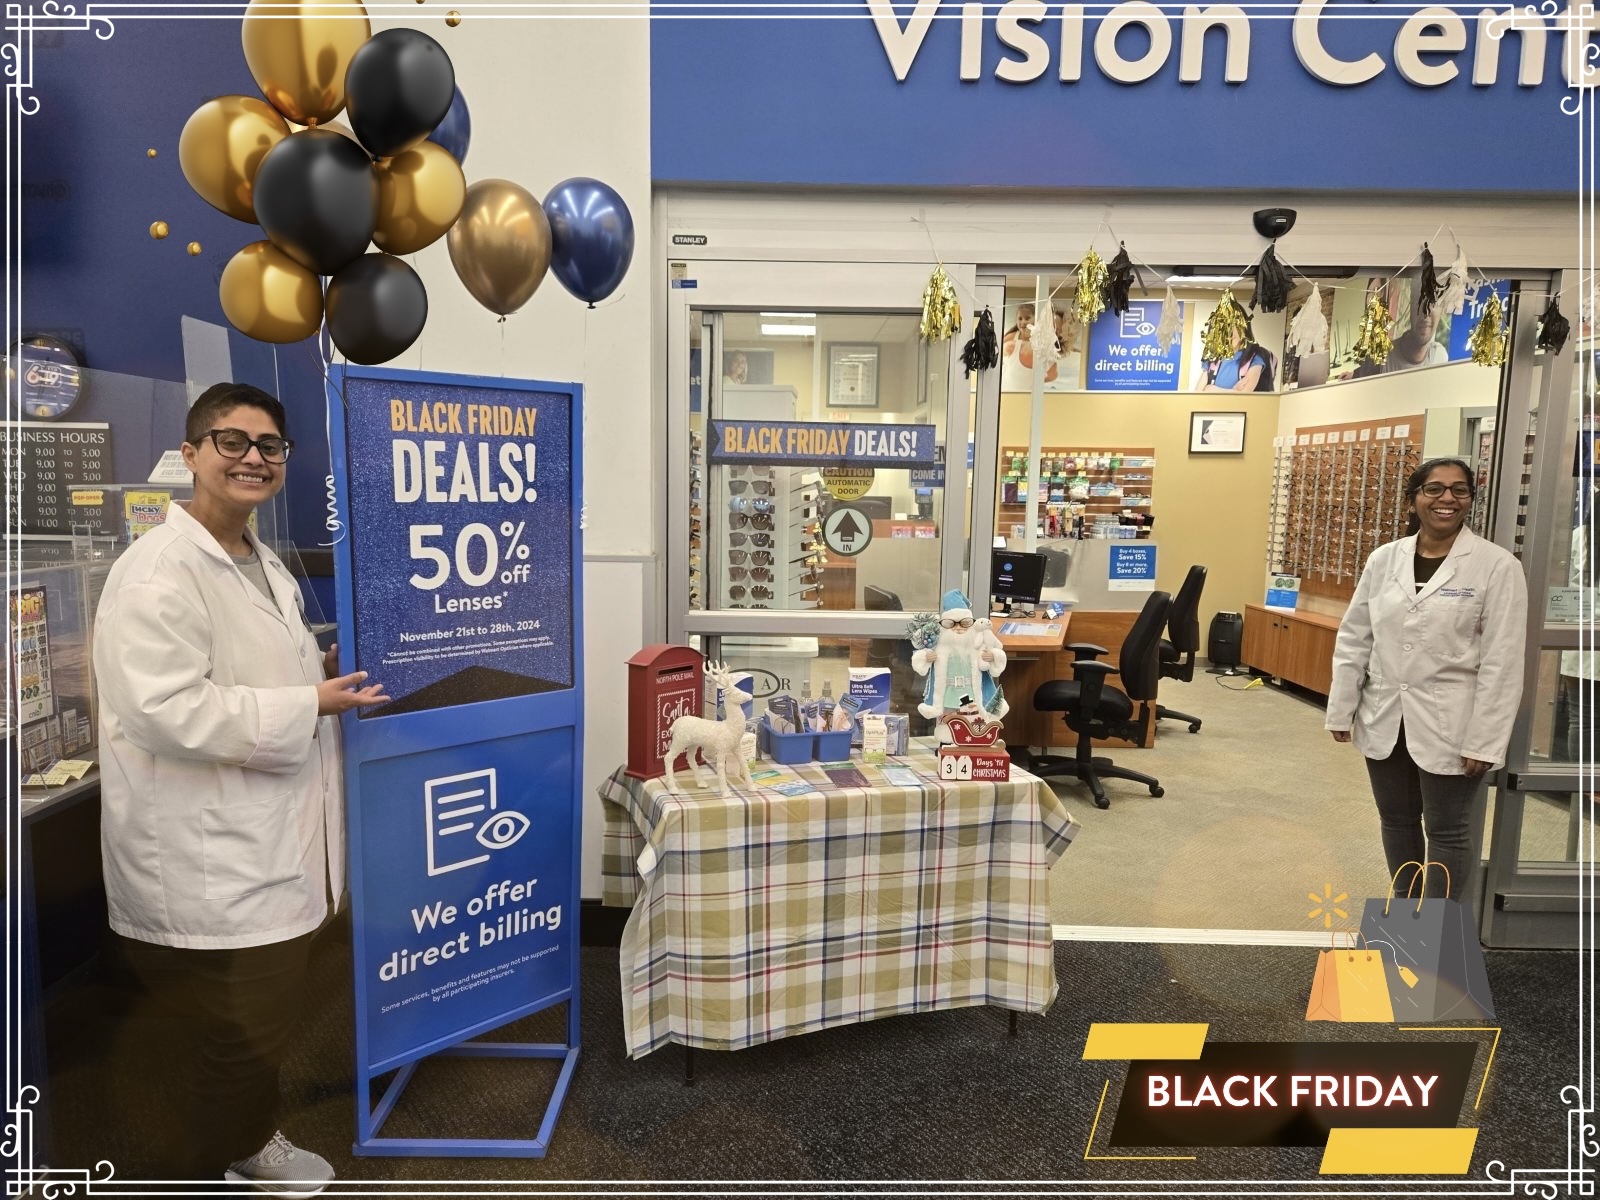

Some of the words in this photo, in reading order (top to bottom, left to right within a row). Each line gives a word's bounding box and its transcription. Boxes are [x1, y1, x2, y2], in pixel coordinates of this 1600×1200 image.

[870, 0, 1251, 84] Vision
[674, 236, 705, 244] STANLEY
[1109, 344, 1128, 357] We
[1094, 359, 1132, 371] direct
[1135, 359, 1174, 374] billing
[390, 399, 463, 434] BLACK
[467, 404, 537, 437] FRIDAY
[0, 431, 55, 443] BUSINESS
[60, 432, 105, 444] HOURS
[724, 426, 783, 455] BLACK
[787, 428, 850, 457] FRIDAY
[854, 430, 918, 458] DEALS!
[392, 439, 538, 504] DEALS!
[823, 467, 873, 477] CAUTION
[912, 470, 936, 480] COME
[826, 479, 871, 487] AUTOMATIC
[842, 543, 852, 552] IN
[409, 521, 530, 591] 50%
[500, 563, 531, 585] off
[399, 629, 454, 643] November
[455, 626, 476, 637] 21st
[477, 626, 488, 635] to
[490, 622, 515, 634] 28th,
[516, 619, 541, 631] 2024
[656, 675, 672, 685] NORTH
[946, 763, 953, 774] 3
[960, 764, 968, 774] 4
[976, 757, 994, 768] Days
[972, 768, 1006, 778] CHRISTMAS
[411, 901, 458, 934] We
[466, 878, 538, 916] offer
[378, 931, 470, 982] direct
[479, 904, 562, 948] billing
[381, 1002, 401, 1014] Some
[431, 980, 457, 995] benefits
[458, 975, 470, 985] and
[471, 967, 496, 980] features
[497, 962, 510, 971] may
[510, 958, 521, 966] not
[530, 943, 560, 960] supported
[432, 995, 441, 1003] by
[441, 990, 450, 999] all
[450, 977, 490, 997] participating
